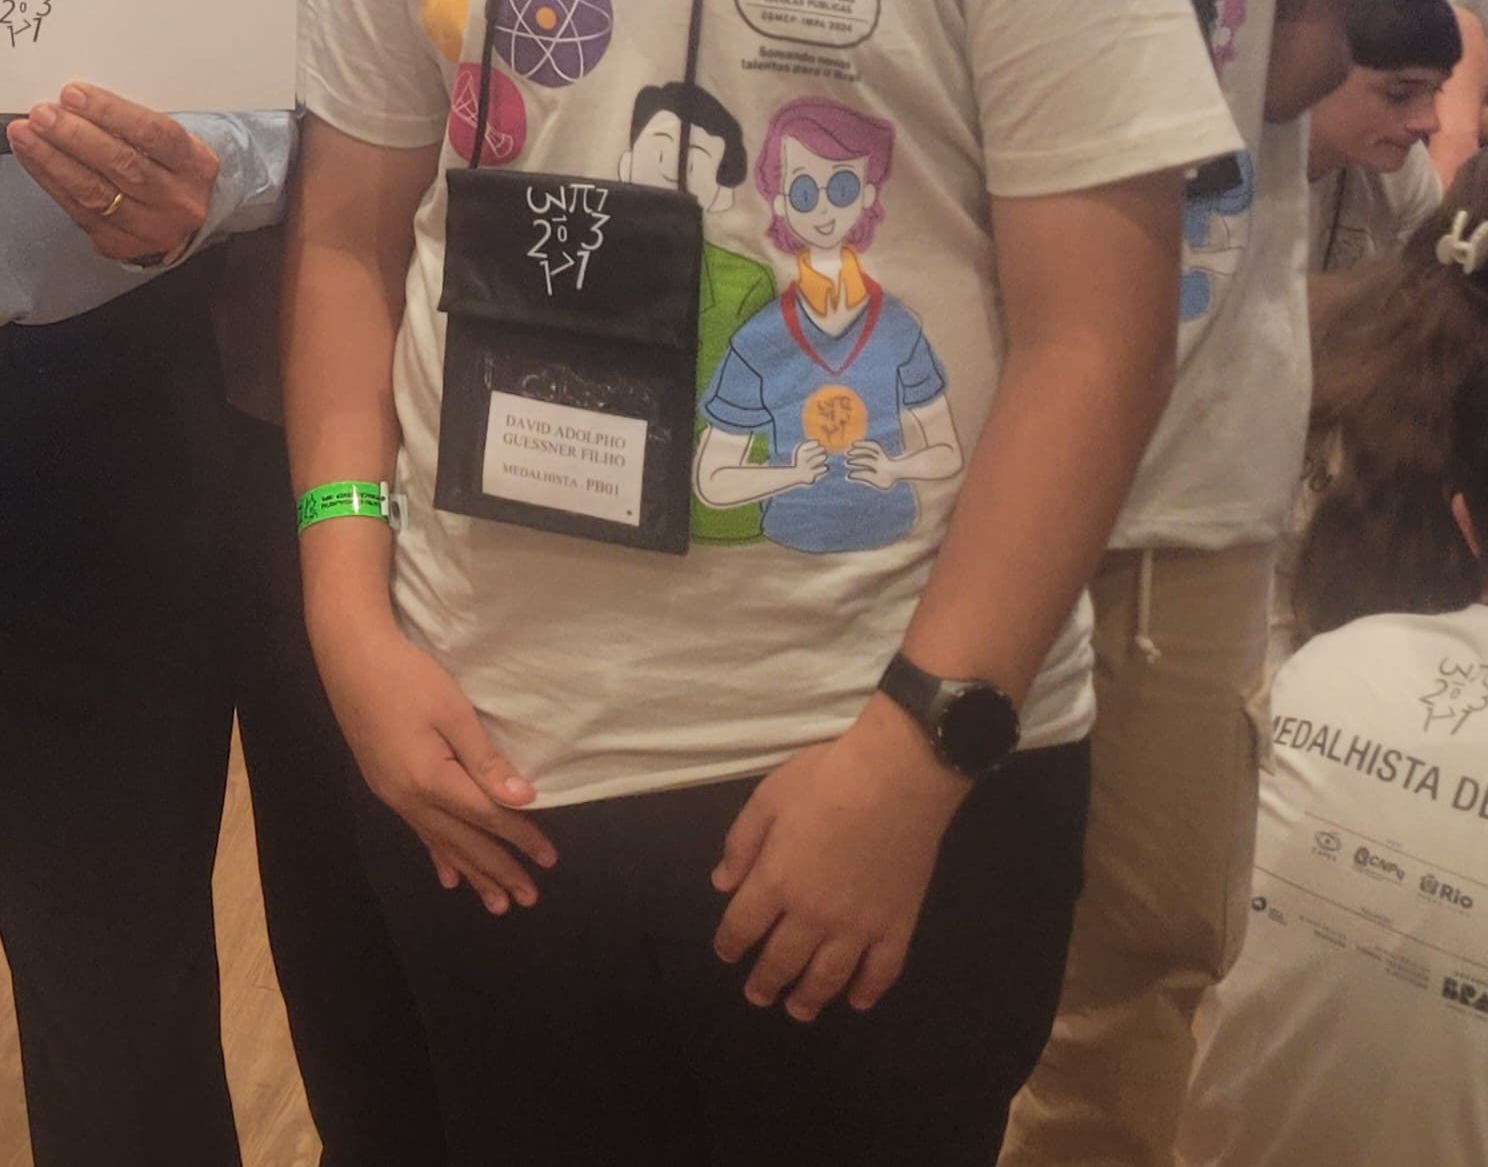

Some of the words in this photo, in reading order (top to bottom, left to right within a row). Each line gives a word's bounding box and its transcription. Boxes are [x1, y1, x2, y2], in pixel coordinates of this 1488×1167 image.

[505, 413, 551, 435] DAVID
[554, 426, 627, 450] ADOLPHO
[502, 432, 577, 458] GUESSNER
[580, 447, 626, 468] FILHO
[502, 463, 578, 489] MEDALHISTA
[585, 477, 619, 497] PB01
[1439, 883, 1474, 909] Rio
